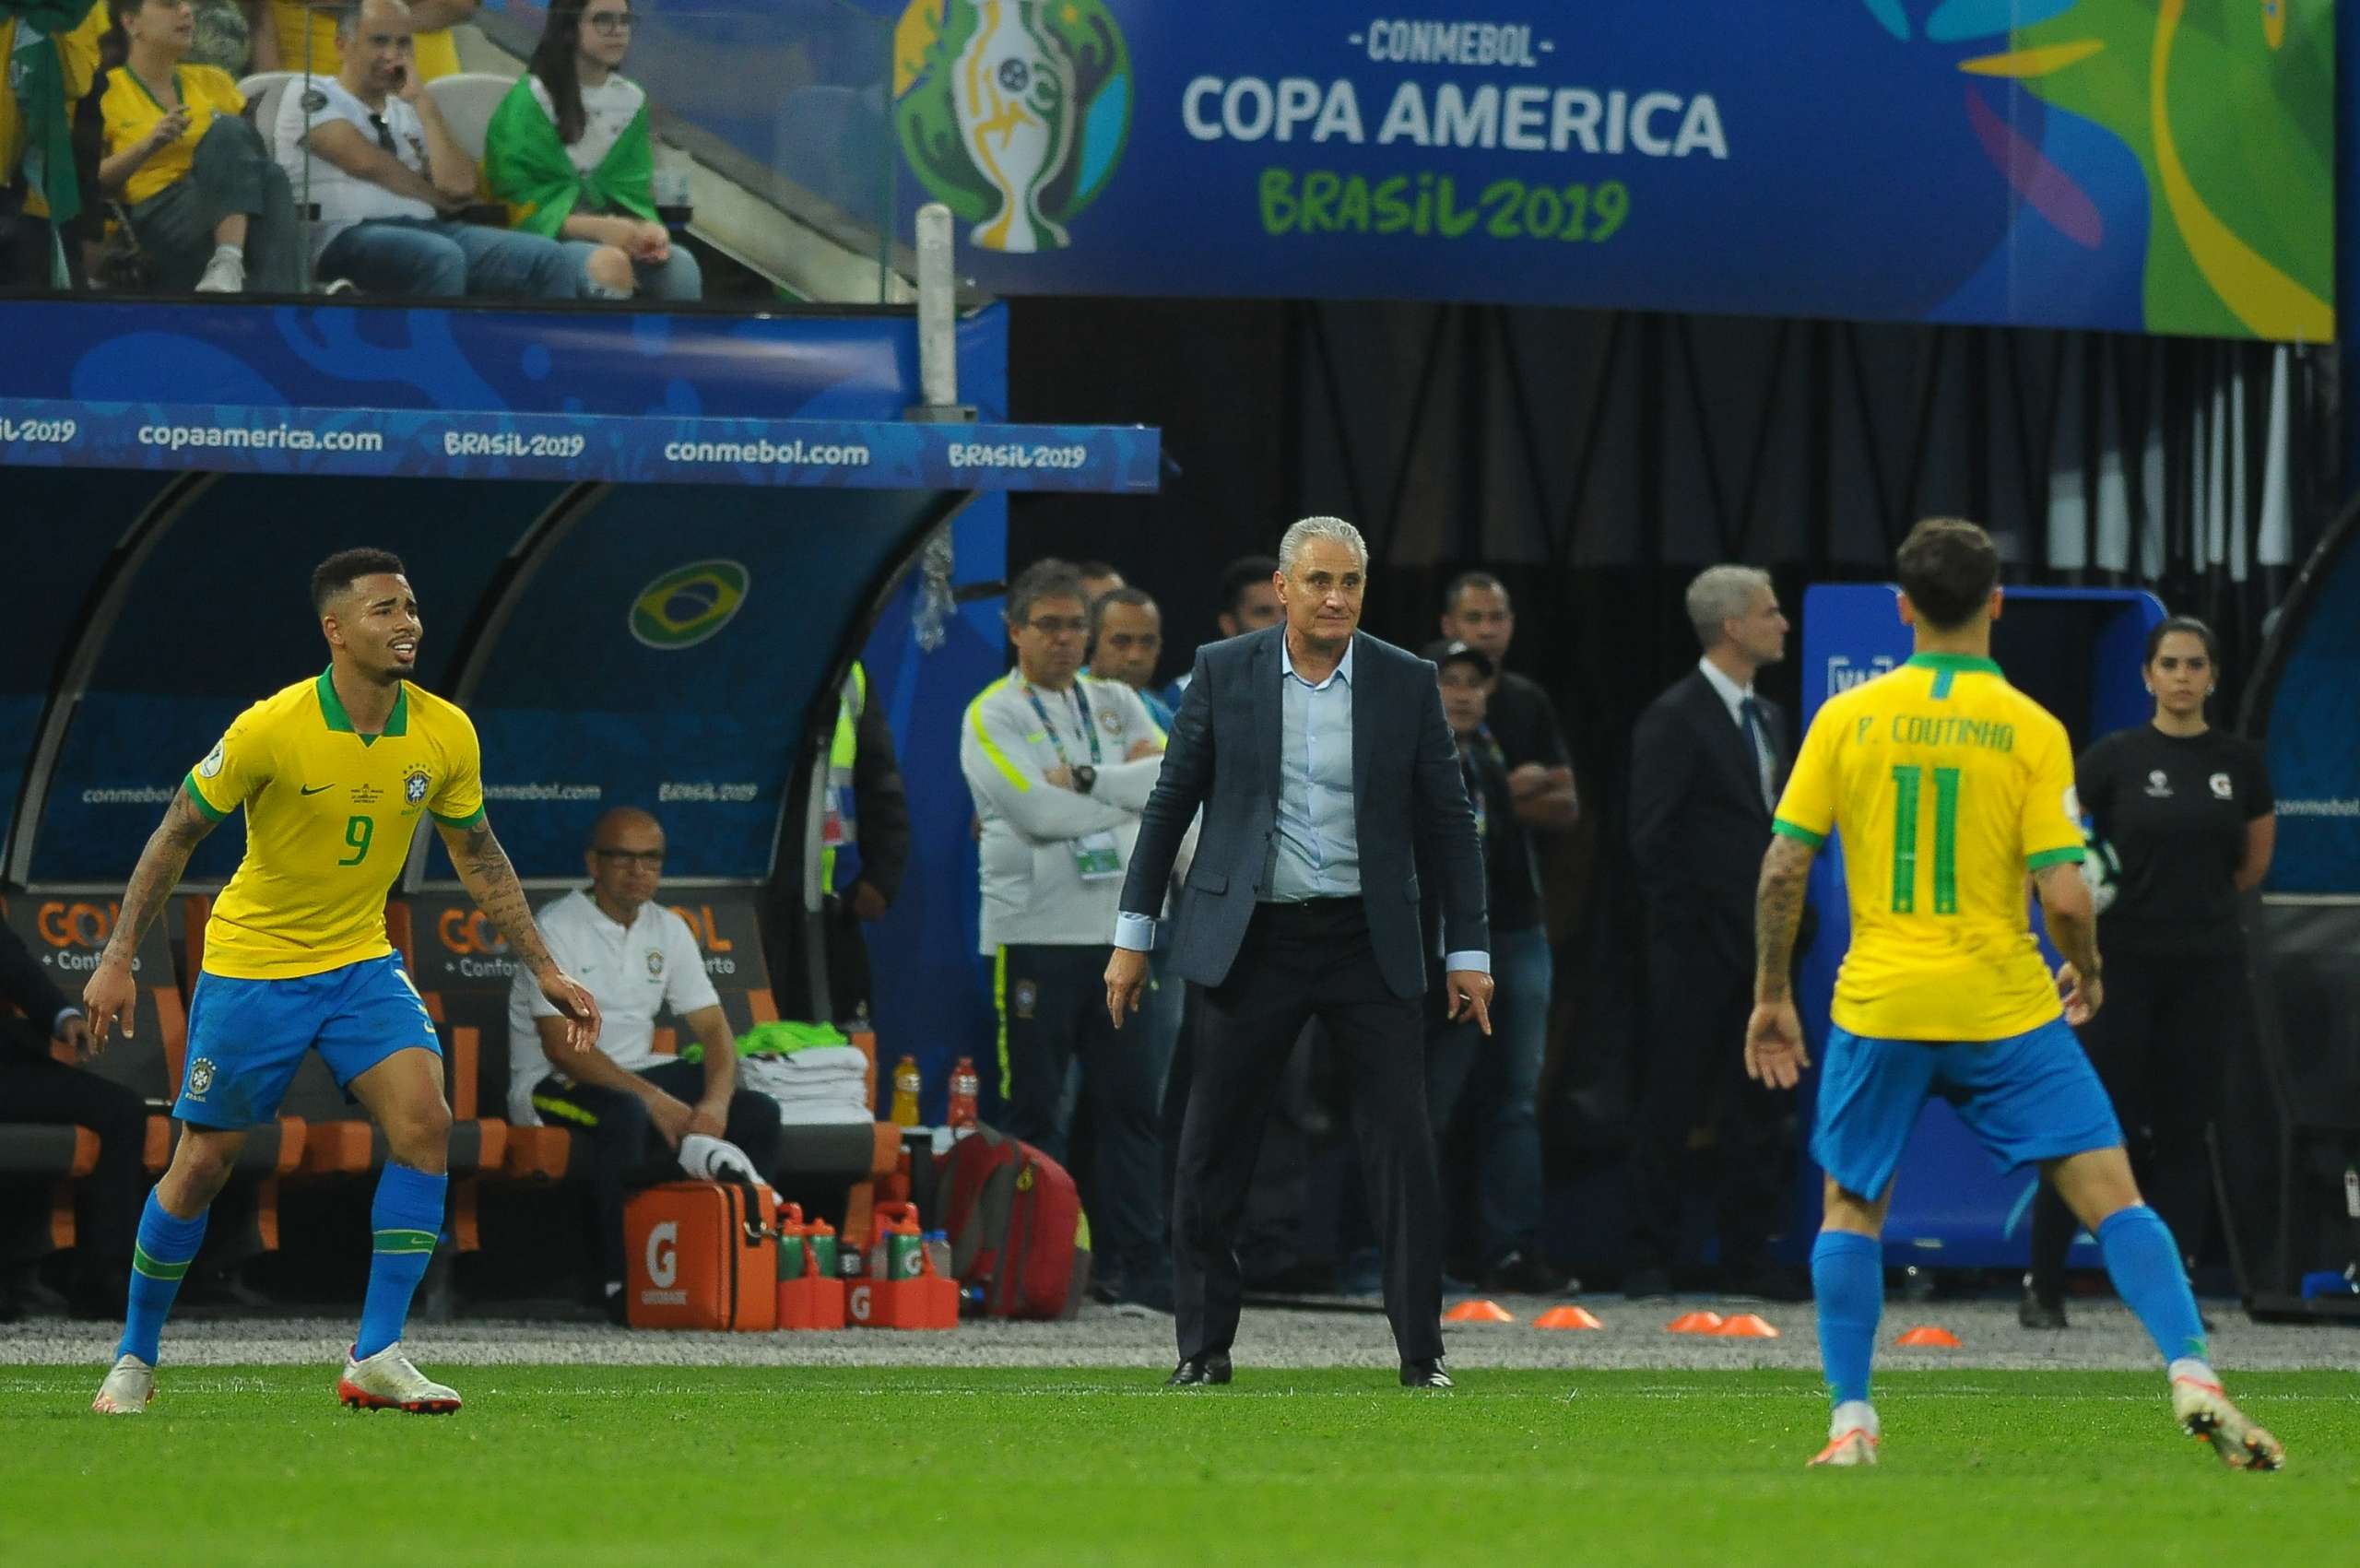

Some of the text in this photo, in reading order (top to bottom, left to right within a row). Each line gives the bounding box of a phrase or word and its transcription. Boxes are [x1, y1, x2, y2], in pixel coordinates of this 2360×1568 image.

[1182, 76, 1729, 159] COPA AMERICA
[1480, 179, 1630, 242] 2019
[137, 423, 384, 452] copaamerica.com
[664, 440, 871, 466] conmebol.com
[1892, 714, 2015, 753] COUTINHO
[81, 786, 174, 804] conmebol
[337, 815, 374, 867] 9
[1892, 764, 1961, 914] 11
[438, 907, 509, 954] GO
[647, 1221, 678, 1288] G
[851, 1286, 871, 1321] G
